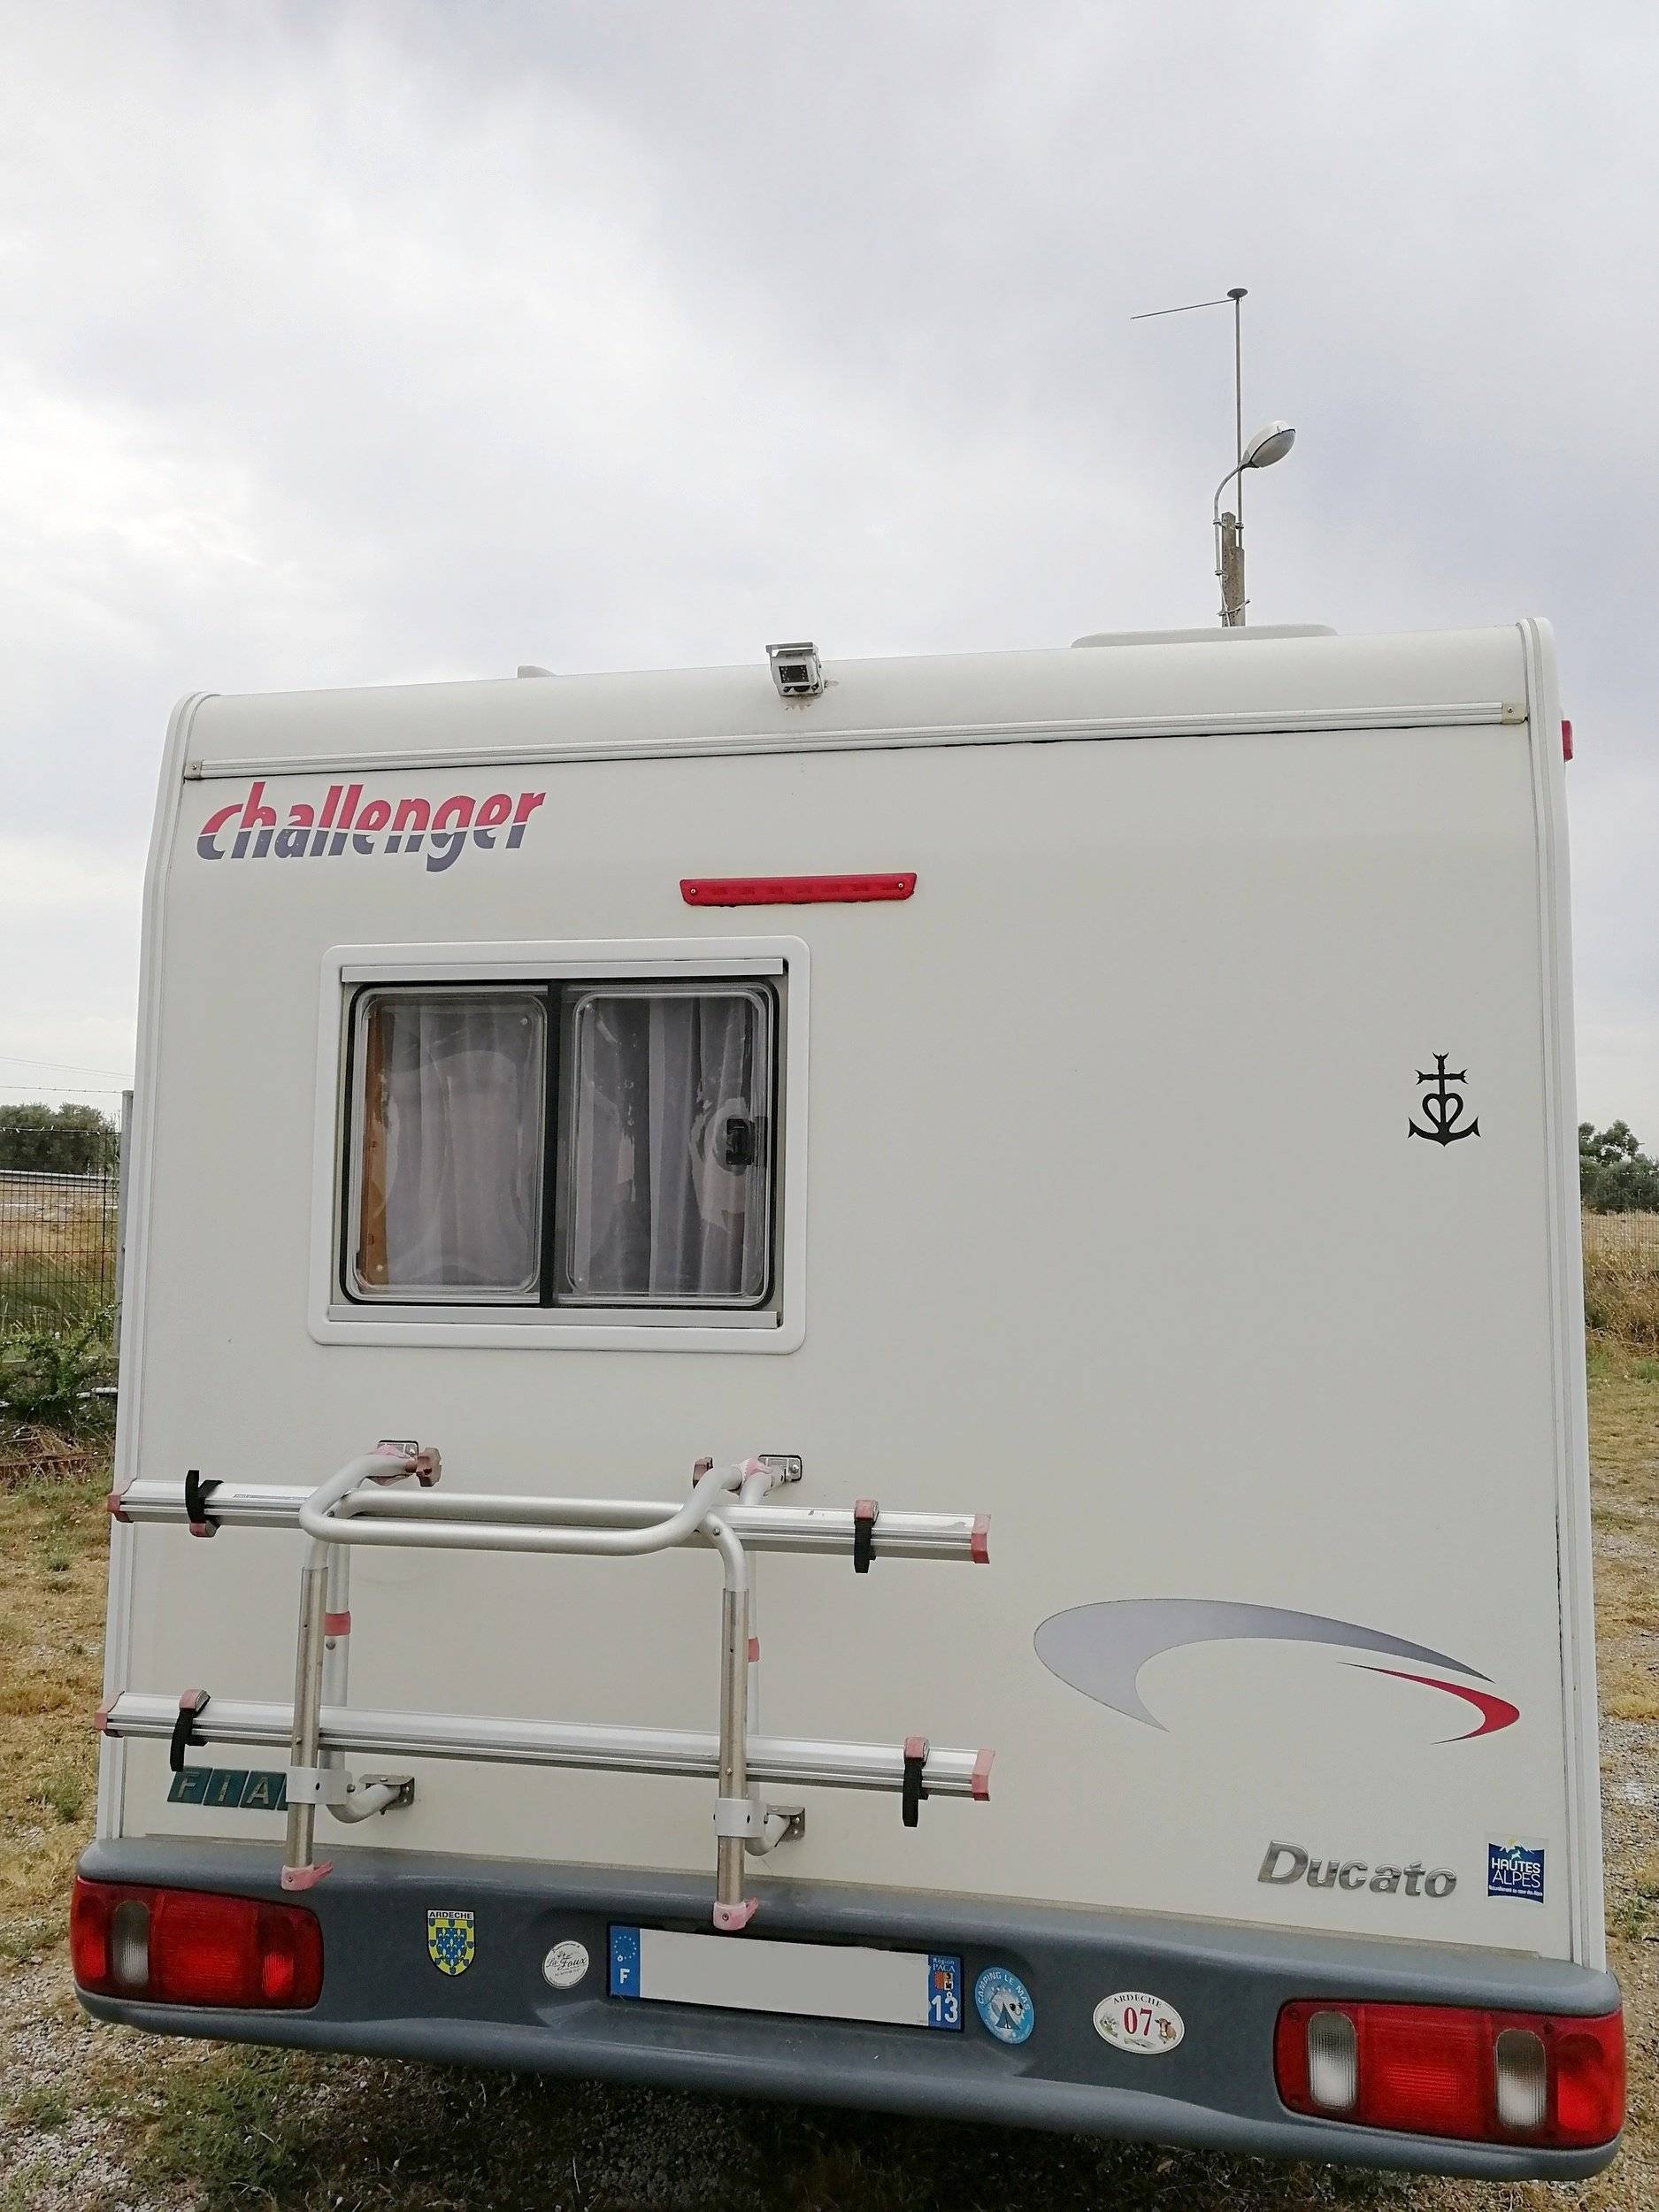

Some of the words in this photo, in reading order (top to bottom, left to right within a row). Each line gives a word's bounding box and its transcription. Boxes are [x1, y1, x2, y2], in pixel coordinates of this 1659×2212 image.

[174, 1770, 273, 1807] FIA
[1257, 1840, 1458, 1898] Ducato
[1491, 1857, 1541, 1874] HAUTES
[1492, 1869, 1541, 1888] ALPES
[428, 1911, 473, 1920] ARDECHE
[619, 1968, 631, 1984] F
[977, 1971, 1002, 2005] CAMPING
[1004, 1973, 1016, 1985] LE
[1015, 1985, 1031, 2011] MAS
[931, 1994, 958, 2024] 13
[1123, 2006, 1153, 2037] 07
